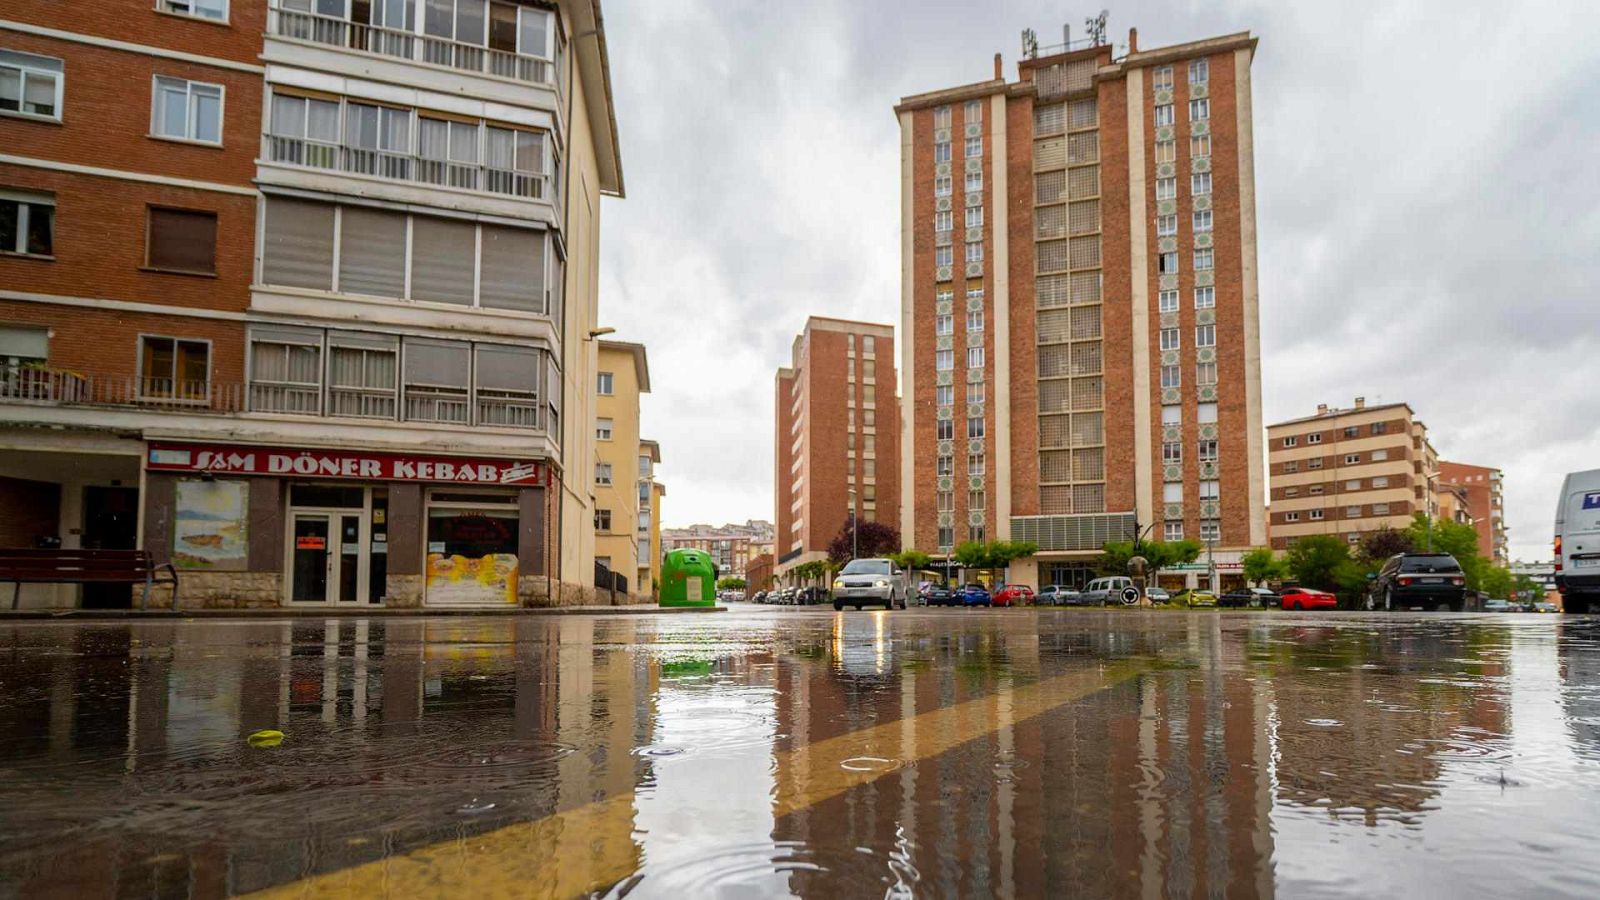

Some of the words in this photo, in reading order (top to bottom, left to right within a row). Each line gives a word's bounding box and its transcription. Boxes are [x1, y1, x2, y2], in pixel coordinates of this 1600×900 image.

[192, 451, 255, 471] SAM
[268, 451, 382, 477] DÖNER
[393, 460, 498, 481] KEBAB
